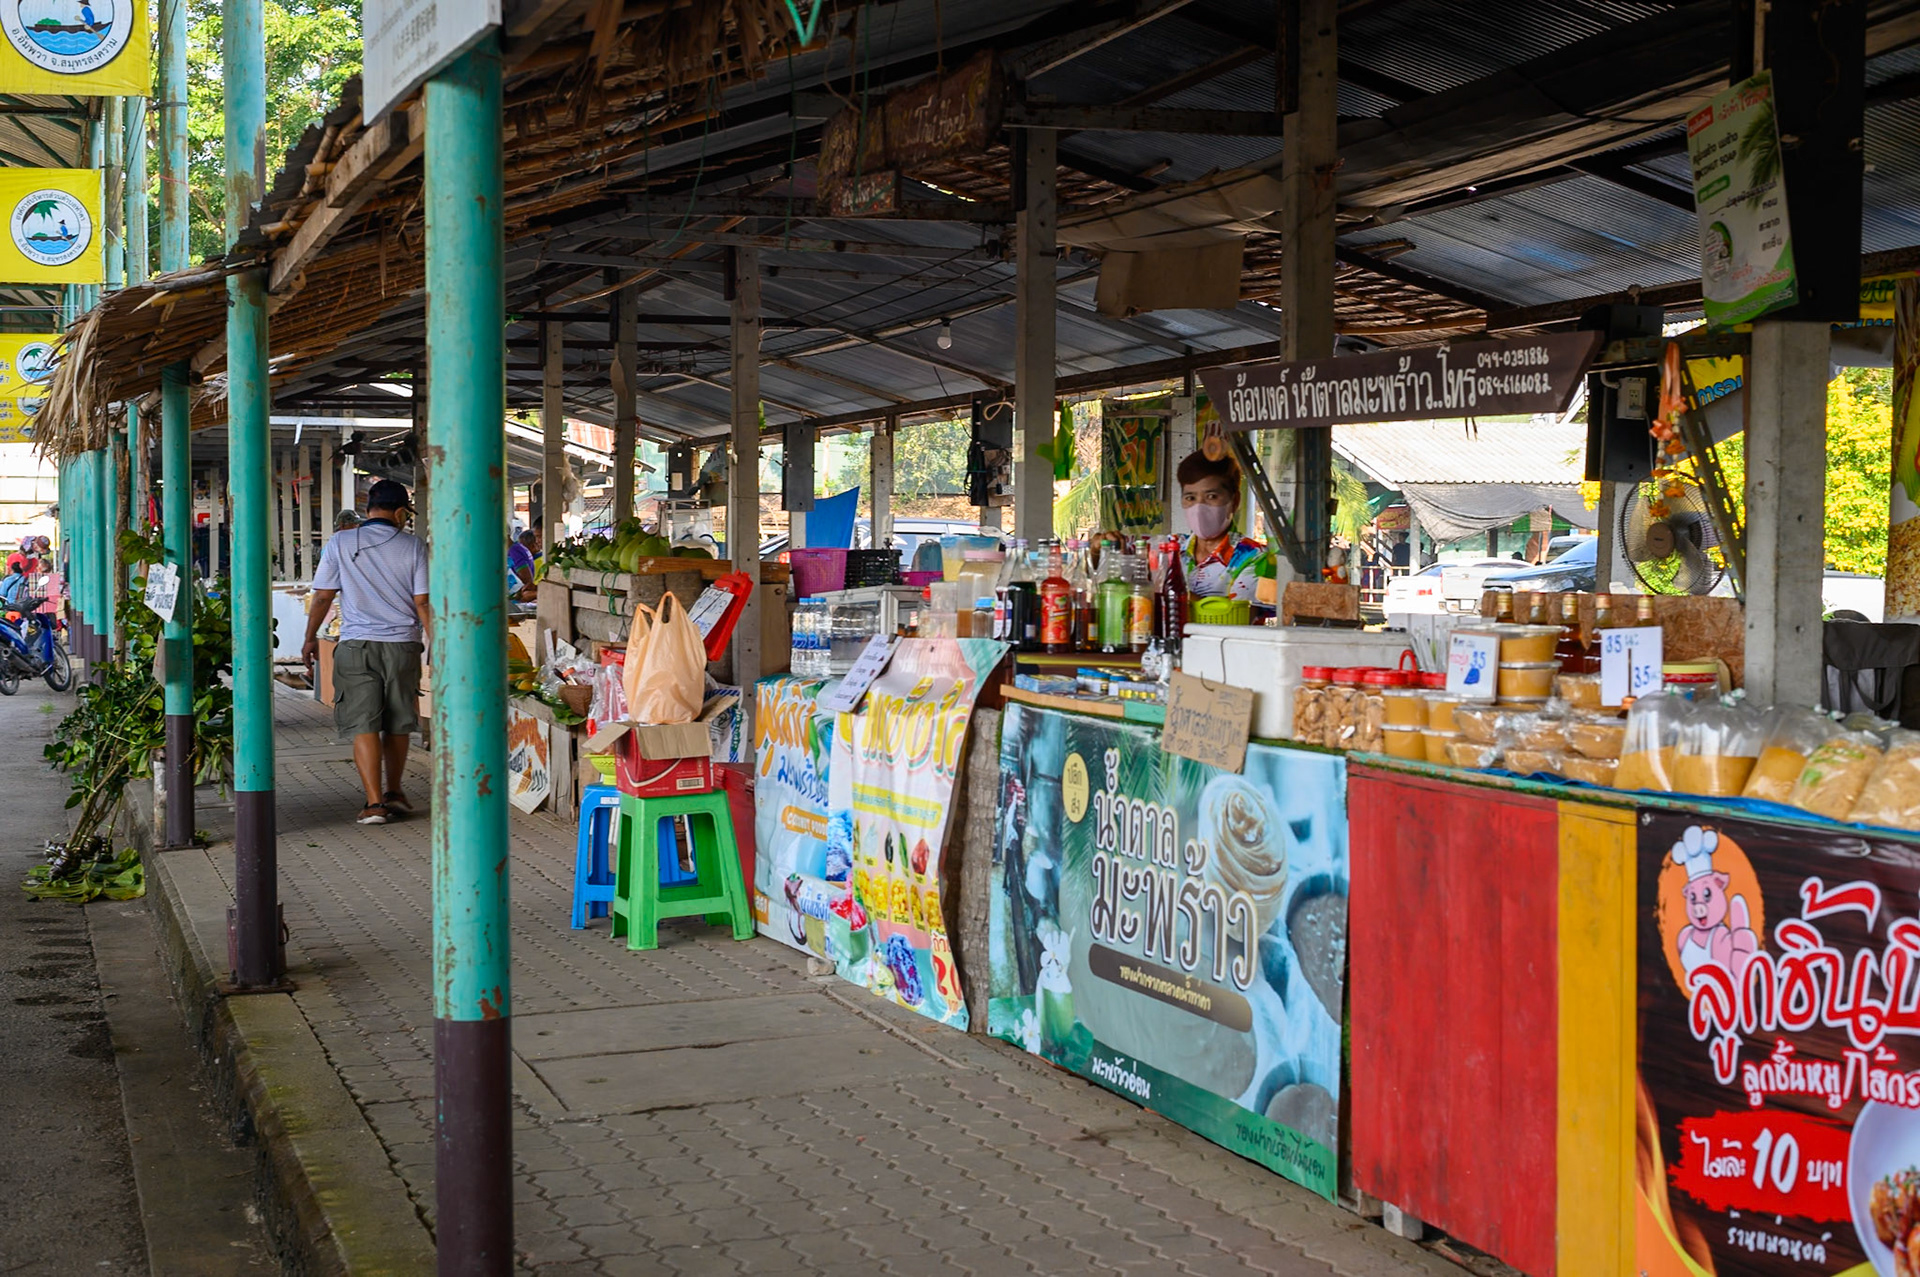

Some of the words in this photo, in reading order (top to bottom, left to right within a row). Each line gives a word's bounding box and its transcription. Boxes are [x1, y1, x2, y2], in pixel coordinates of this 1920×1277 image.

[12, 27, 48, 62] อ.อัมพวา
[51, 38, 118, 70] จ.สมุทรสงคราม
[1228, 368, 1289, 423] เจ้อนงค์
[1470, 650, 1486, 670] 35
[1605, 634, 1622, 653] 35
[1634, 665, 1651, 688] 35
[1094, 748, 1178, 868] น้ำตาล
[1091, 839, 1258, 990] มะพร้าว
[1092, 1056, 1151, 1100] มะพร้าวอ่อน
[1690, 1130, 1746, 1178] ไม้ละ
[1752, 1127, 1800, 1194] 10
[1806, 1159, 1843, 1191] บาท
[1727, 1210, 1832, 1264] ร้านแม่อนงค์
